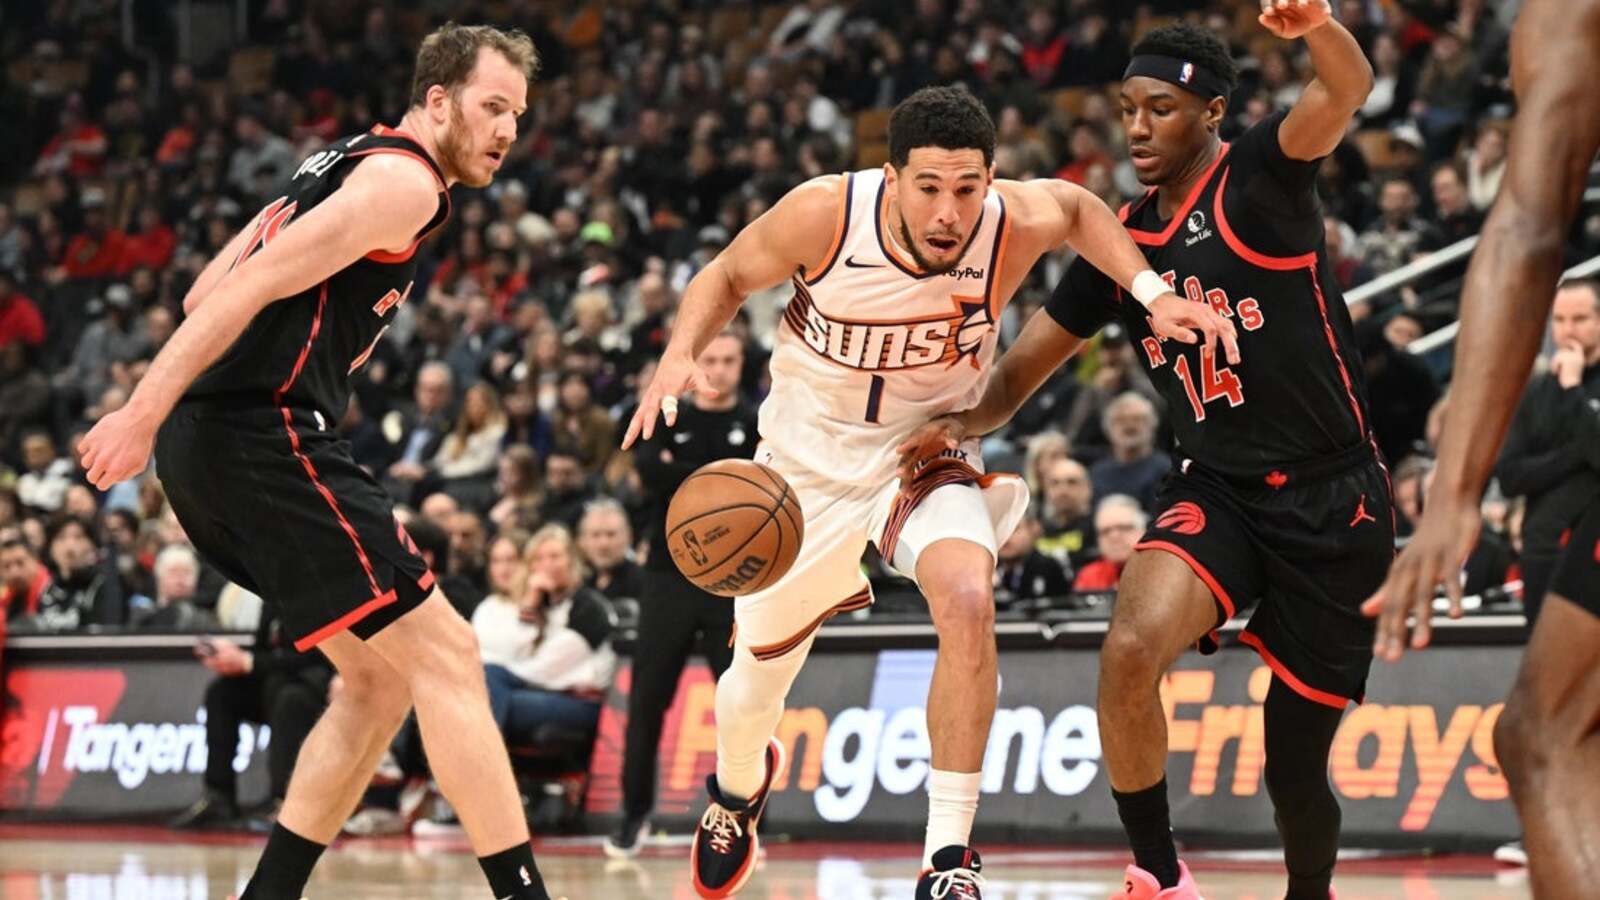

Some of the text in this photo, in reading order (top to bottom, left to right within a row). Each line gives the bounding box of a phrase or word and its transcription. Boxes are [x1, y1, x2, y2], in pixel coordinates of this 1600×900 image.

[942, 267, 984, 280] ayPal
[865, 374, 885, 424] 1
[1174, 344, 1245, 423] 14
[1158, 666, 1510, 831] Friays
